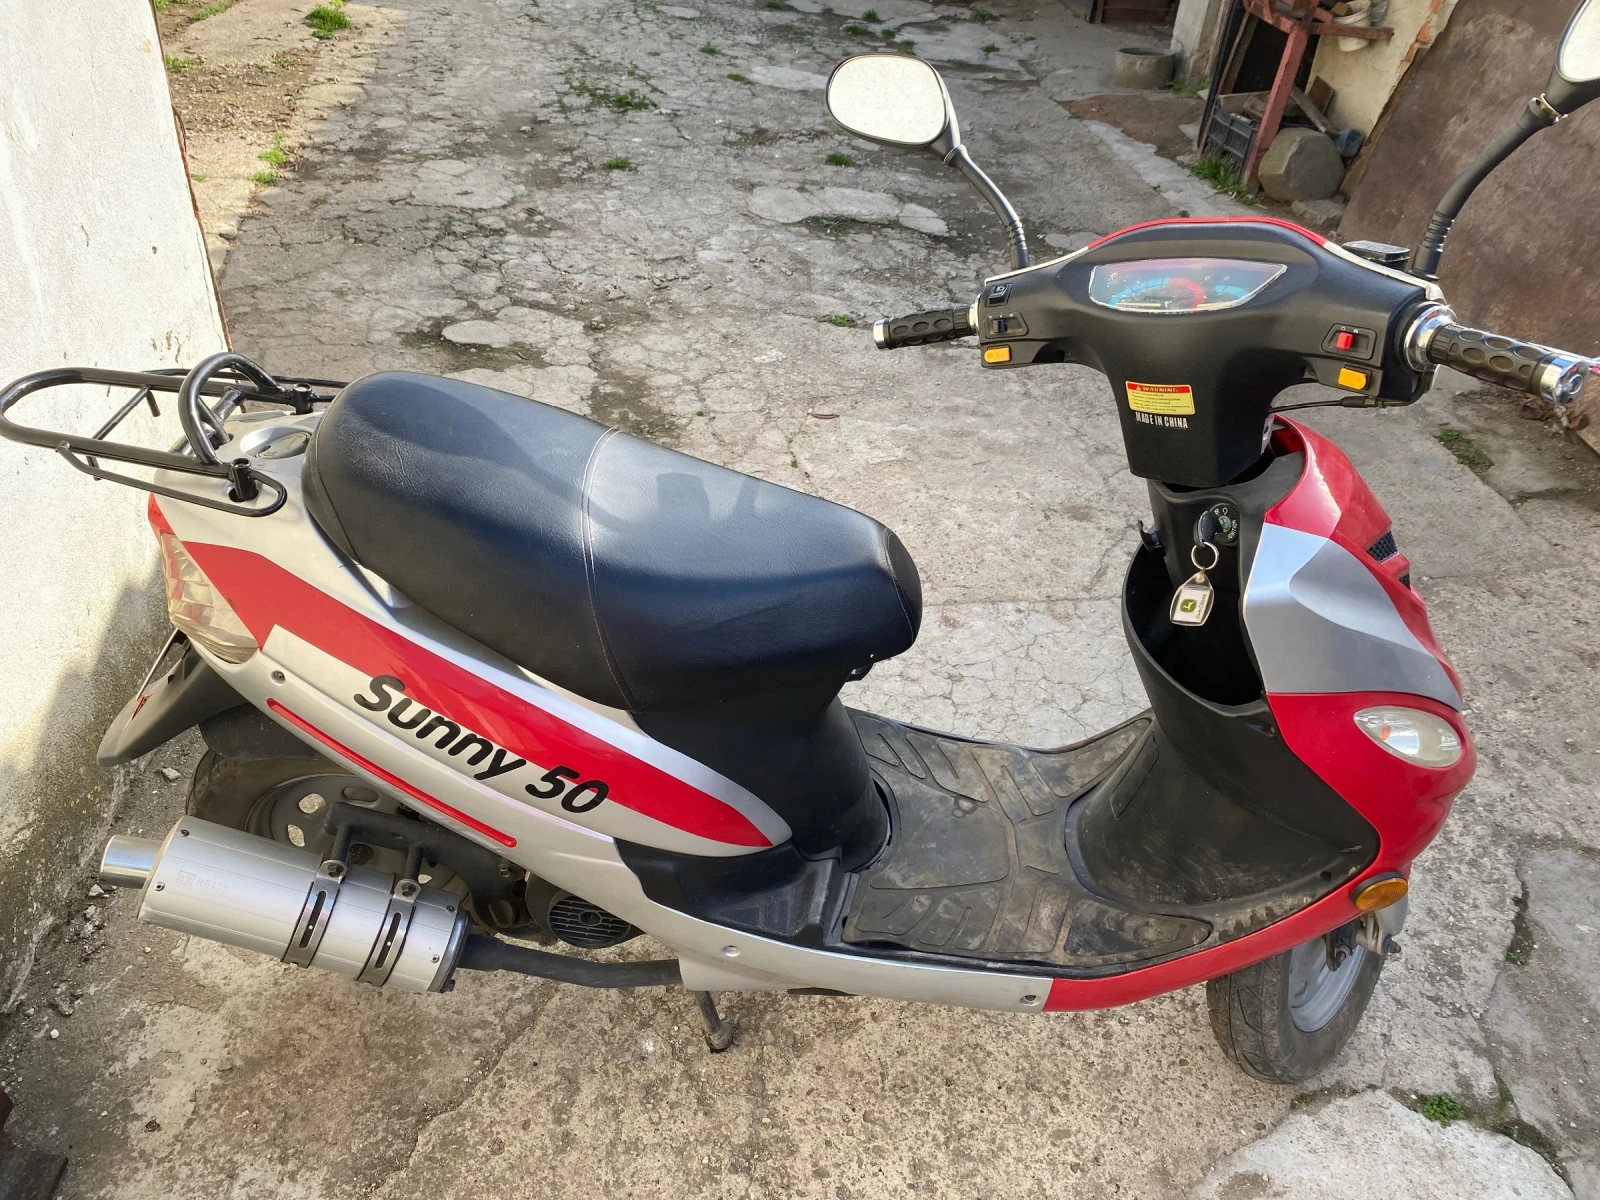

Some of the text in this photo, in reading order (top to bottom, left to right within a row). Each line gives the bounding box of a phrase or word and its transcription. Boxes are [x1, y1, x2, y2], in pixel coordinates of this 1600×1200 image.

[1135, 411, 1189, 429] MADE IN CHINA
[353, 674, 609, 814] Sunny 50
